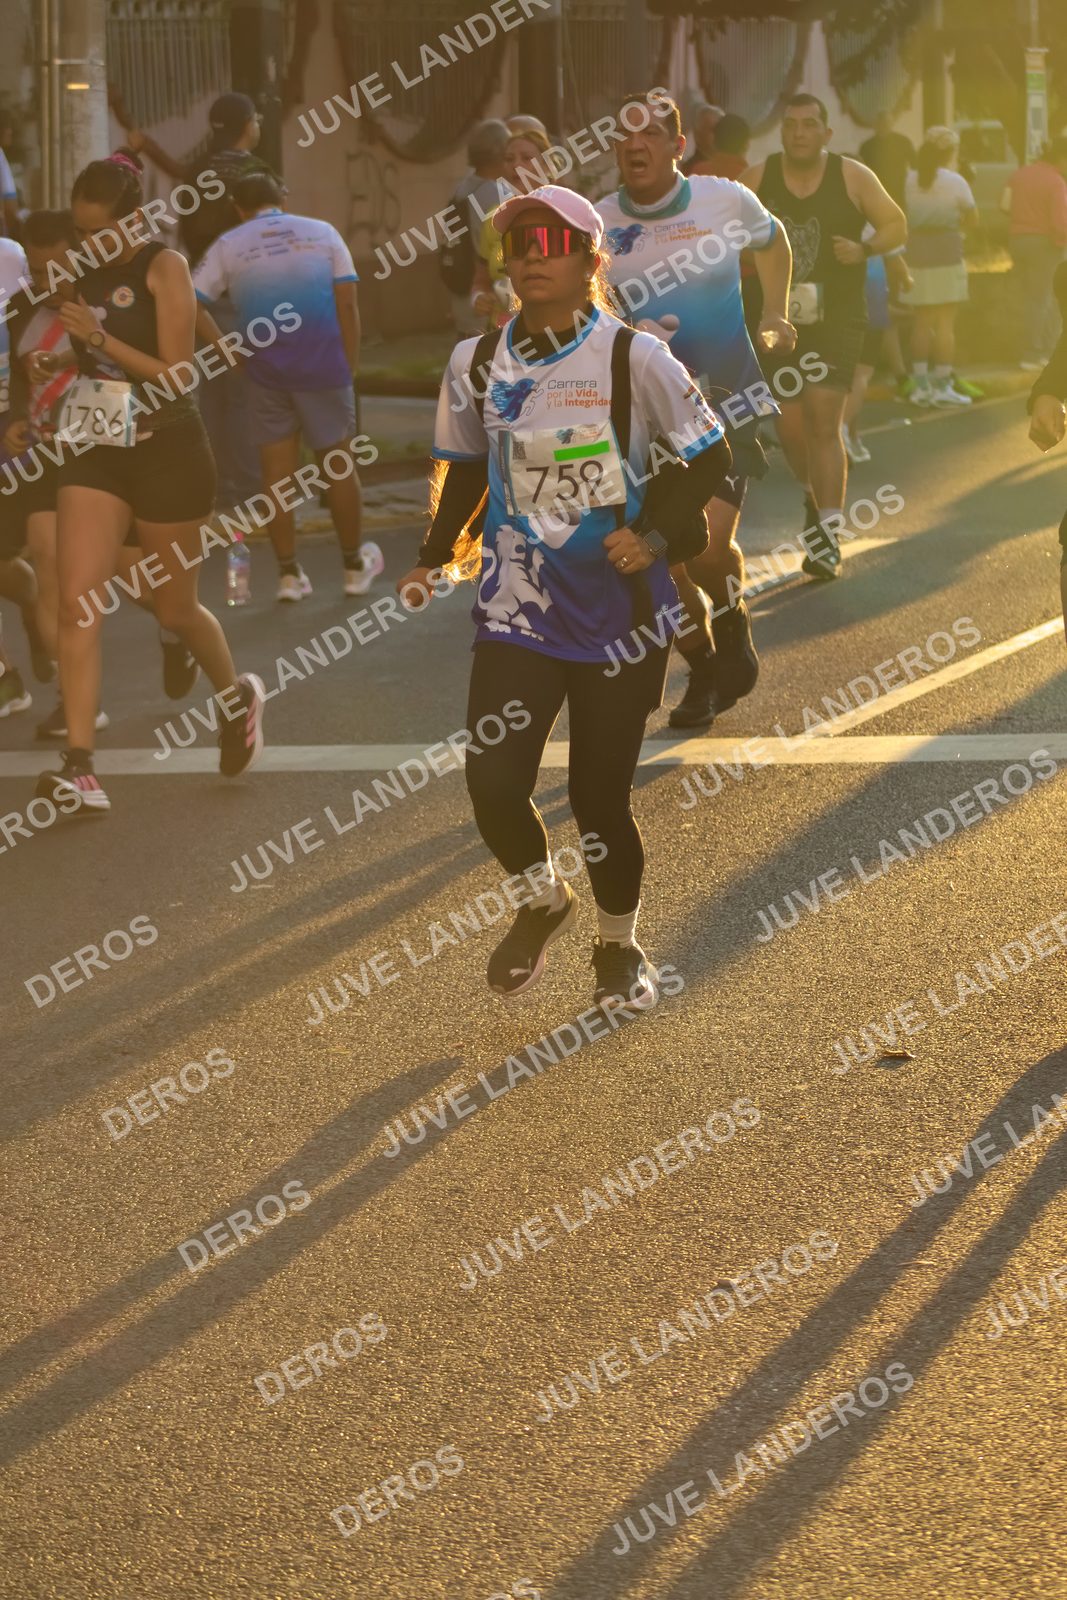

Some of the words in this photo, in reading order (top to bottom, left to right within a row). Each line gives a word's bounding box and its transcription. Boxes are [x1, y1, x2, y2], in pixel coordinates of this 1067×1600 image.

[547, 379, 598, 390] Carrera
[546, 391, 564, 400] por
[565, 390, 574, 398] la
[575, 388, 599, 398] Vida
[554, 399, 562, 408] la
[64, 404, 125, 437] 1786
[526, 460, 604, 504] 759
